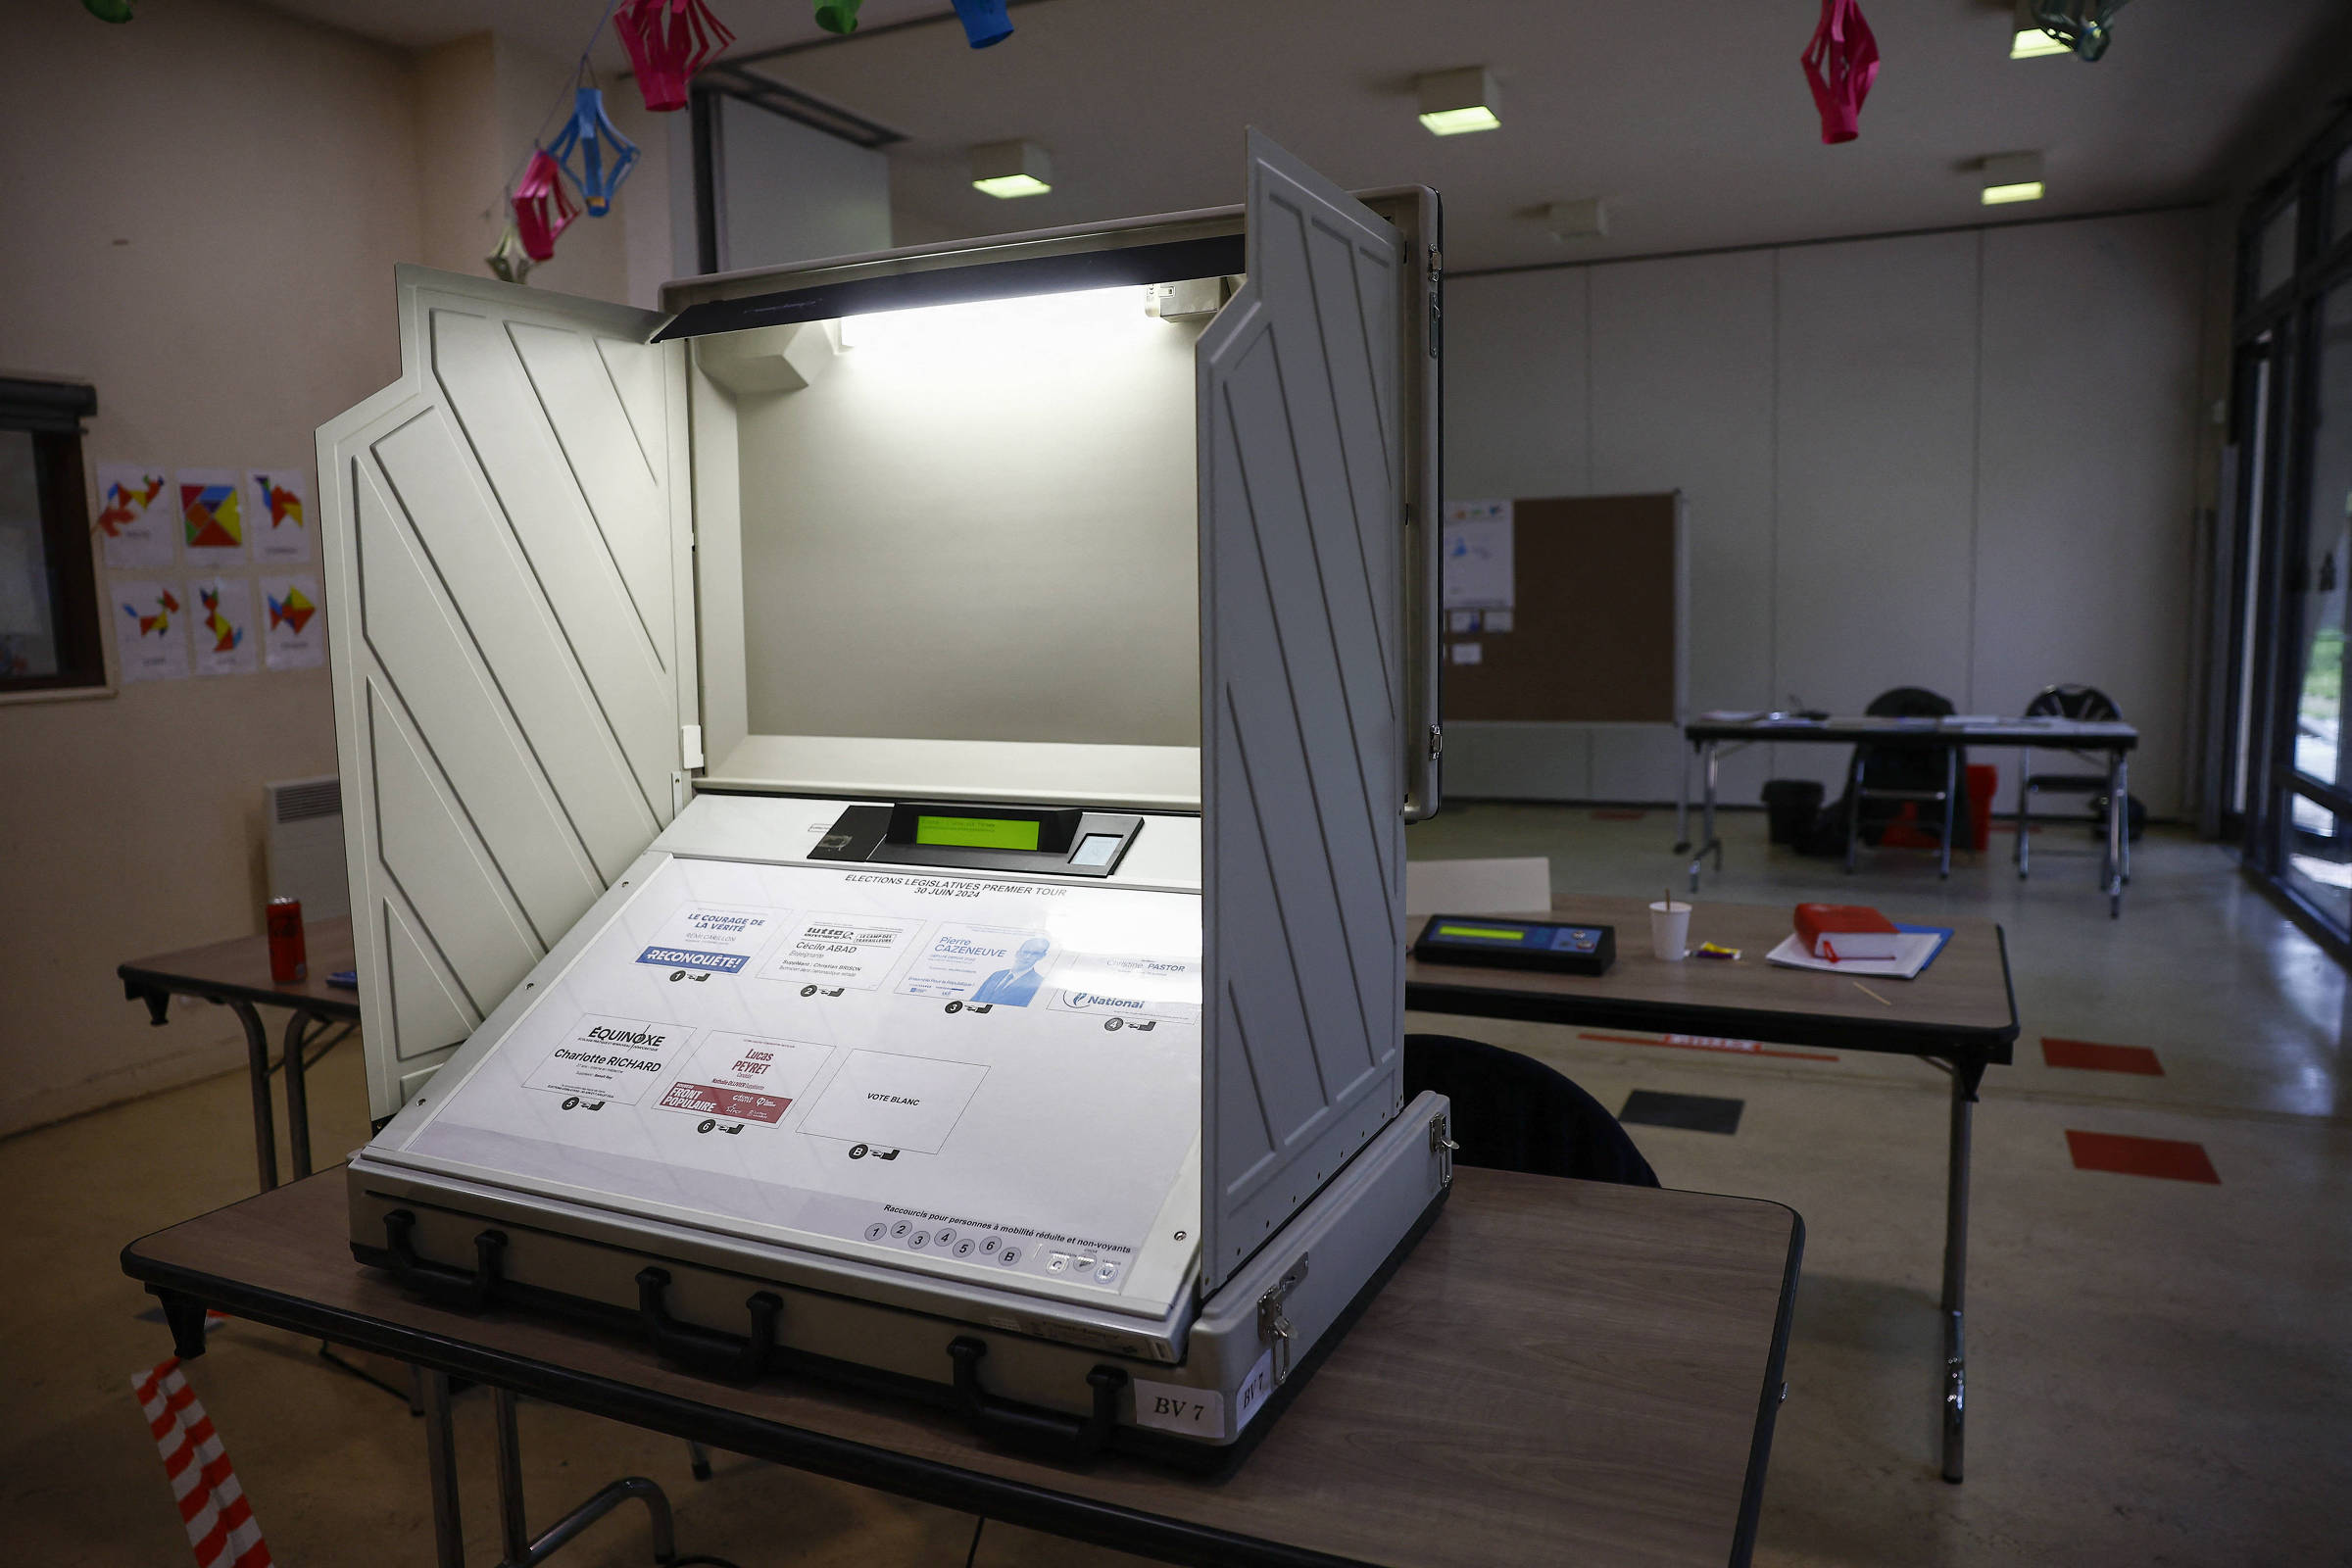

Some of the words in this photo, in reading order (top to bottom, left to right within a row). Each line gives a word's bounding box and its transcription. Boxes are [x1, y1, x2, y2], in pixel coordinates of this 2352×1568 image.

[845, 874, 904, 886] ELECTIONS
[905, 878, 981, 890] LEGISLATIVES
[982, 884, 1038, 895] PREMIER
[1039, 887, 1067, 897] TOUR
[956, 890, 981, 899] 2024
[701, 914, 749, 925] COURAGE
[796, 941, 825, 951] Cécile
[826, 944, 858, 954] ABAD
[939, 936, 971, 946] Pierre
[934, 944, 1007, 957] CAZENEUVE
[1147, 963, 1186, 973] PASTOR
[554, 1049, 607, 1064] Charlotte
[606, 1056, 662, 1073] RICHARD
[745, 1048, 774, 1061] Lucas
[731, 1060, 771, 1075] PEYRET
[668, 1087, 703, 1100] FRONT
[867, 1093, 890, 1102] VOTE
[890, 1096, 920, 1106] BLANC
[662, 1096, 717, 1112] POPULAIRE
[883, 1203, 928, 1218] Raccourcis
[928, 1212, 949, 1224] pour
[949, 1215, 993, 1230] personnes
[1000, 1223, 1035, 1237] mobilité
[1035, 1230, 1065, 1244] réduite
[1066, 1236, 1076, 1245] et
[1076, 1238, 1132, 1254] non-voyants
[871, 1227, 881, 1238] 1
[896, 1224, 906, 1235] 2
[914, 1235, 924, 1246] 3
[940, 1232, 951, 1244] 4
[958, 1244, 968, 1254] 5
[986, 1240, 996, 1250] 6
[1004, 1250, 1015, 1262] B
[1243, 1379, 1257, 1409] BV
[1258, 1371, 1264, 1391] 7
[1154, 1396, 1187, 1418] BV
[1193, 1404, 1204, 1421] 7
